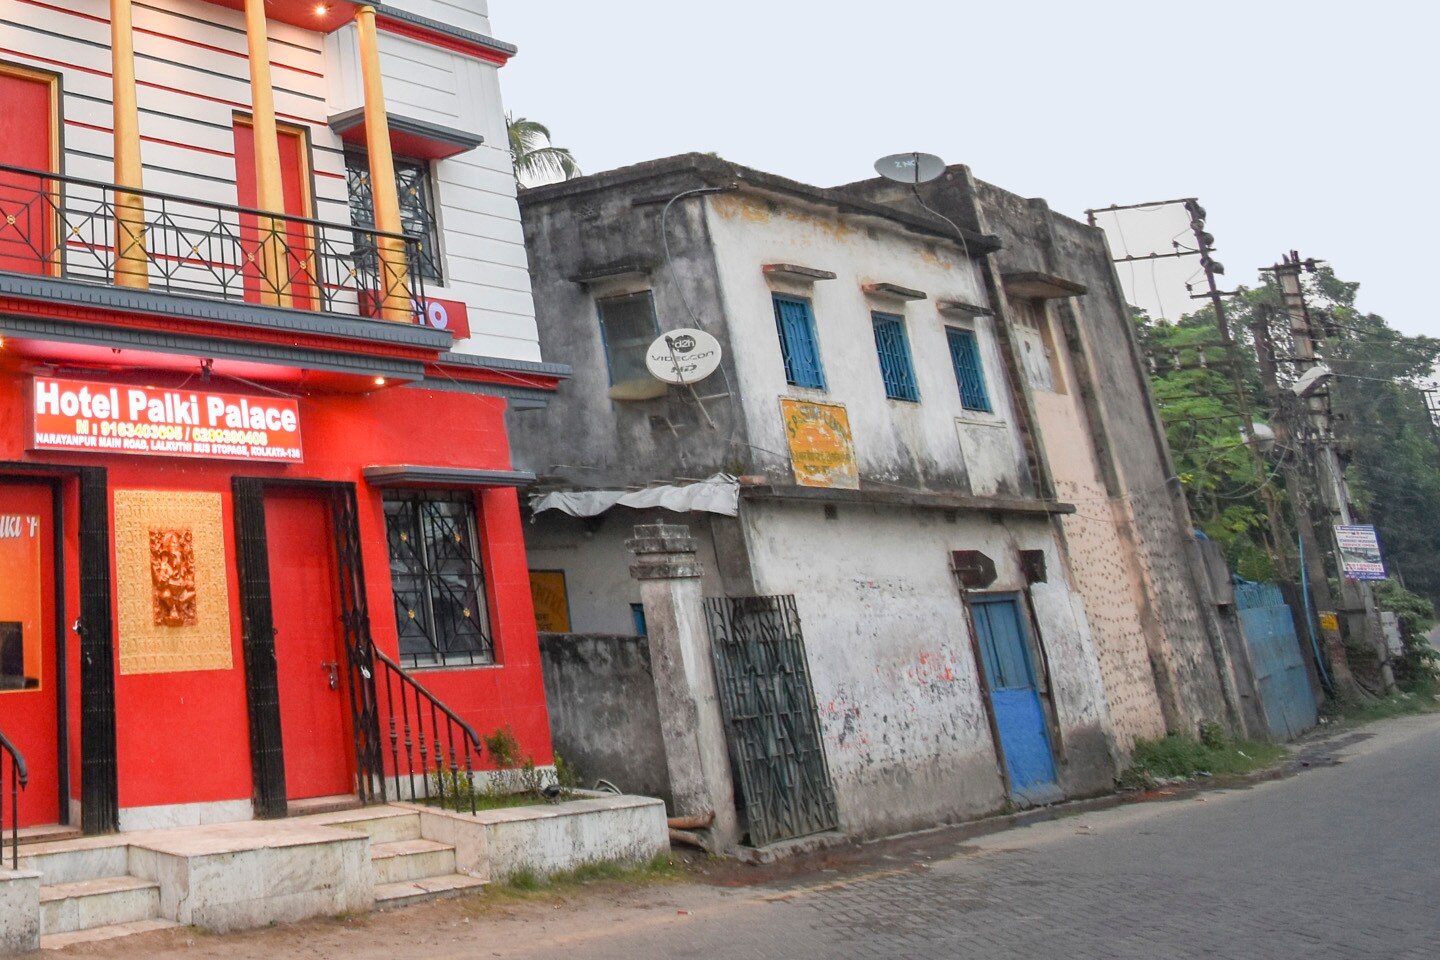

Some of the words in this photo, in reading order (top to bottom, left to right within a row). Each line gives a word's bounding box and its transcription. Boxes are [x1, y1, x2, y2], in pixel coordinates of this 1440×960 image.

[674, 339, 695, 348] d2h
[36, 381, 119, 419] Hotel
[128, 390, 200, 426] Palki
[206, 396, 297, 432] Palace
[35, 432, 97, 447] NARAYANPUR
[98, 436, 122, 448] MAIN
[123, 438, 149, 451] ROAD,
[193, 442, 211, 454] BUS
